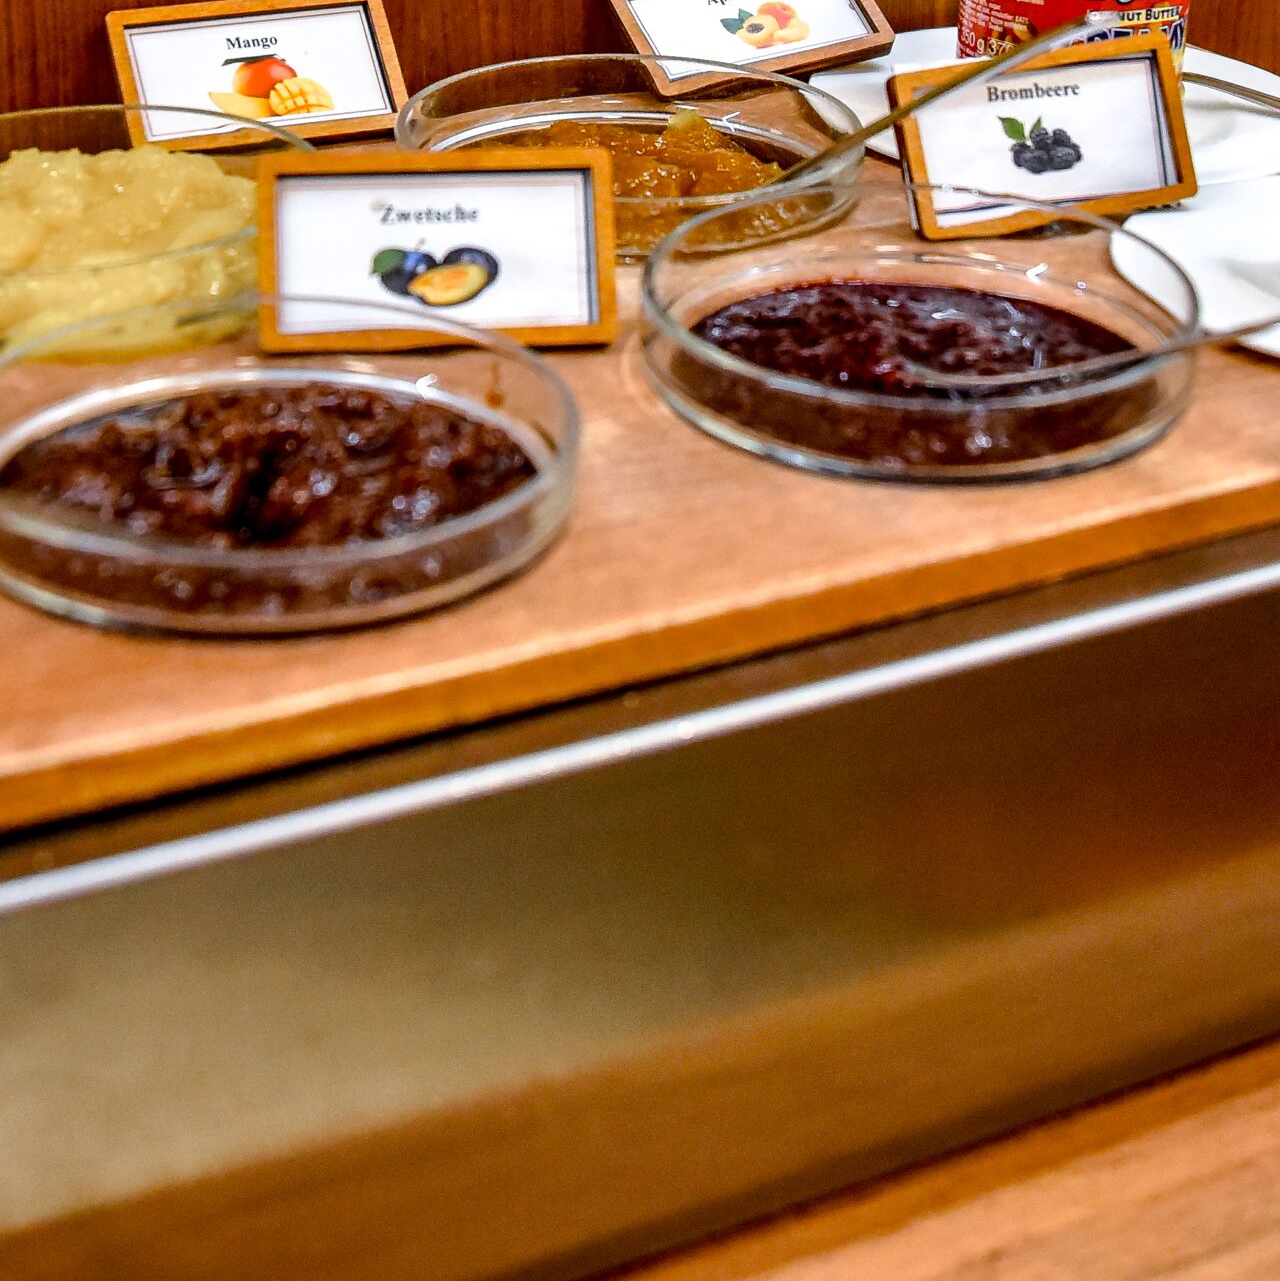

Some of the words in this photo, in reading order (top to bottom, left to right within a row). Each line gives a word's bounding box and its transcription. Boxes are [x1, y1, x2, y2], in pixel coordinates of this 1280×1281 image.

[226, 35, 279, 51] Mango
[986, 82, 1081, 103] Brombeere
[380, 203, 480, 225] Zwetsche
